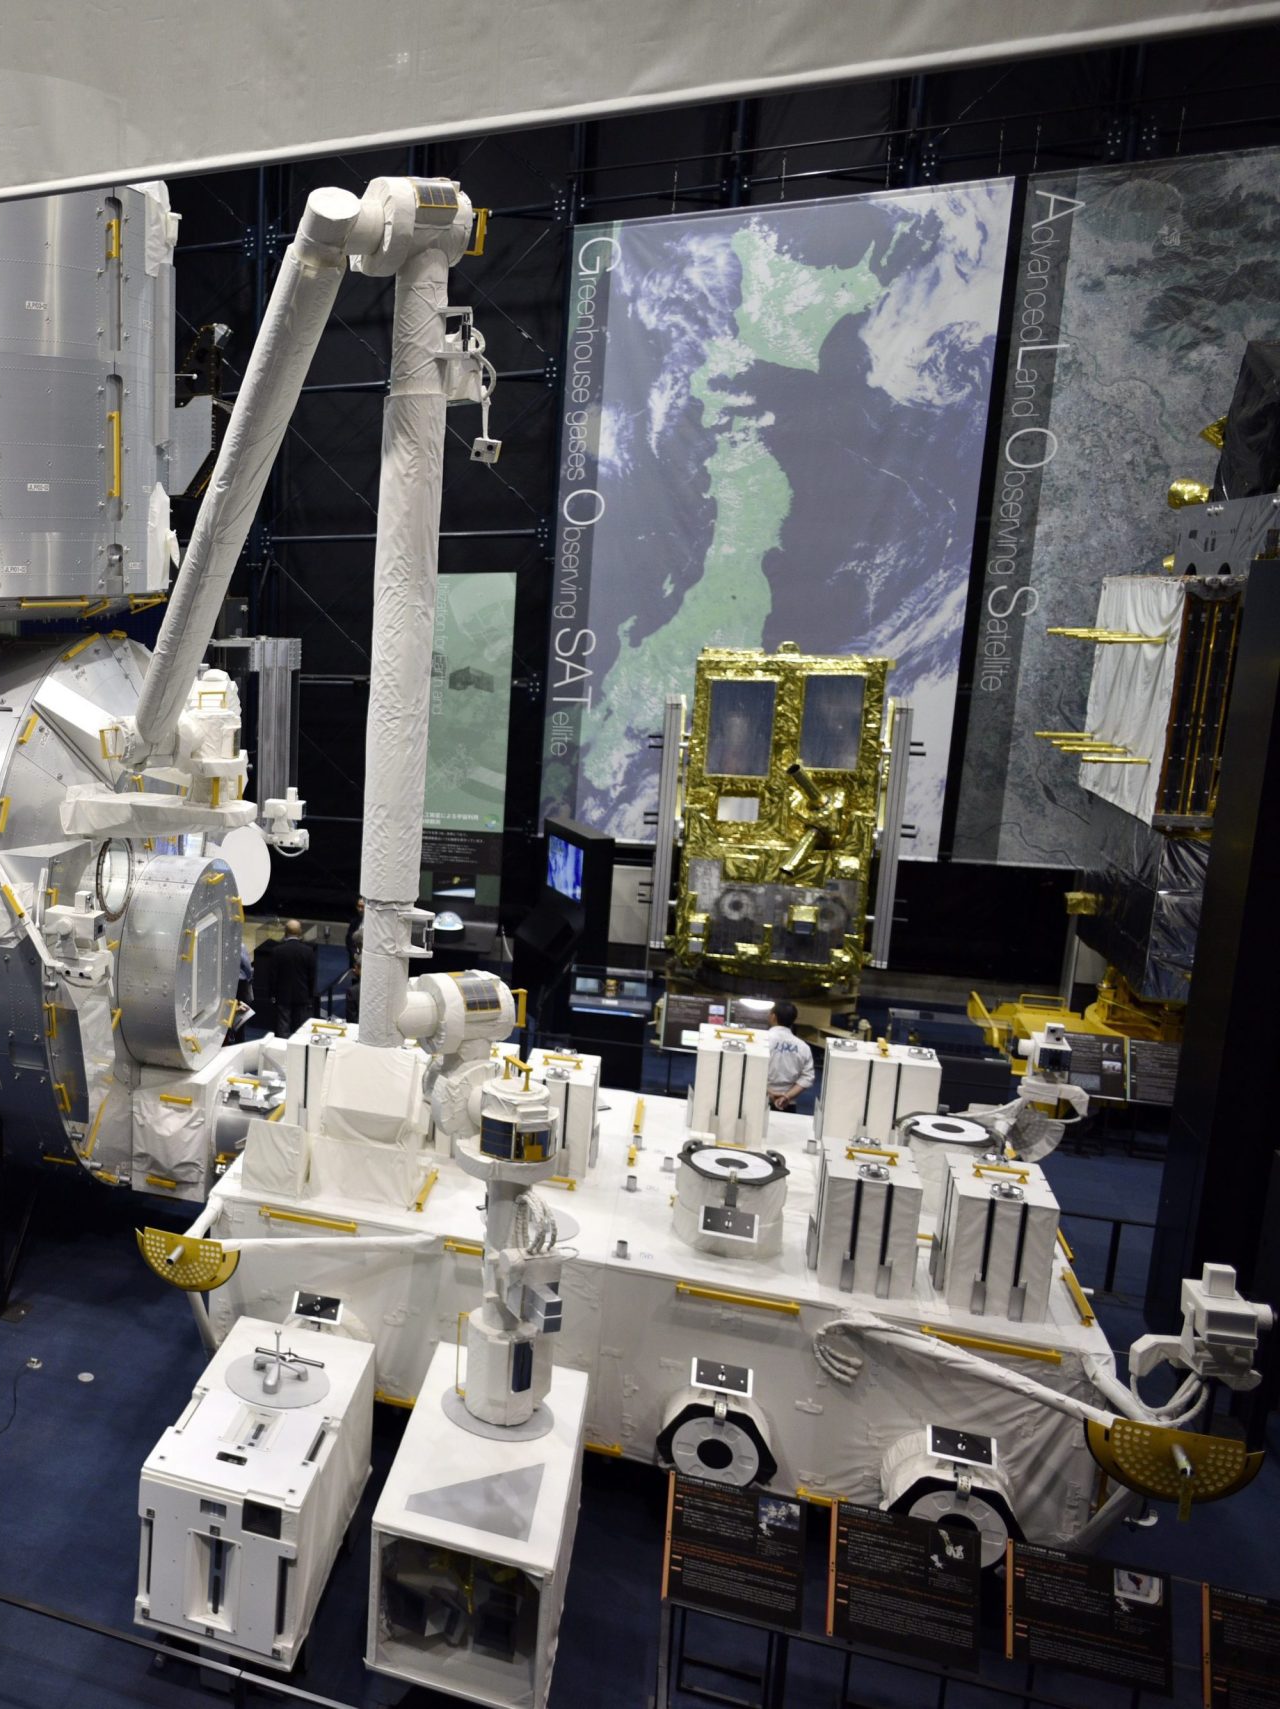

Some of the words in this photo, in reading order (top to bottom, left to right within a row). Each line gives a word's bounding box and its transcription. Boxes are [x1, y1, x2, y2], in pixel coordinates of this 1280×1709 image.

[1019, 189, 1086, 342] Advanced
[571, 236, 622, 404] Greenhouse
[1011, 343, 1070, 418] Land
[565, 410, 589, 481] gases
[987, 427, 1058, 576] Observing
[553, 488, 606, 619] Observing
[435, 575, 451, 632] Utilization
[980, 585, 1040, 692] Satellite
[431, 655, 449, 690] Earth
[433, 635, 449, 654] for
[430, 692, 445, 716] and
